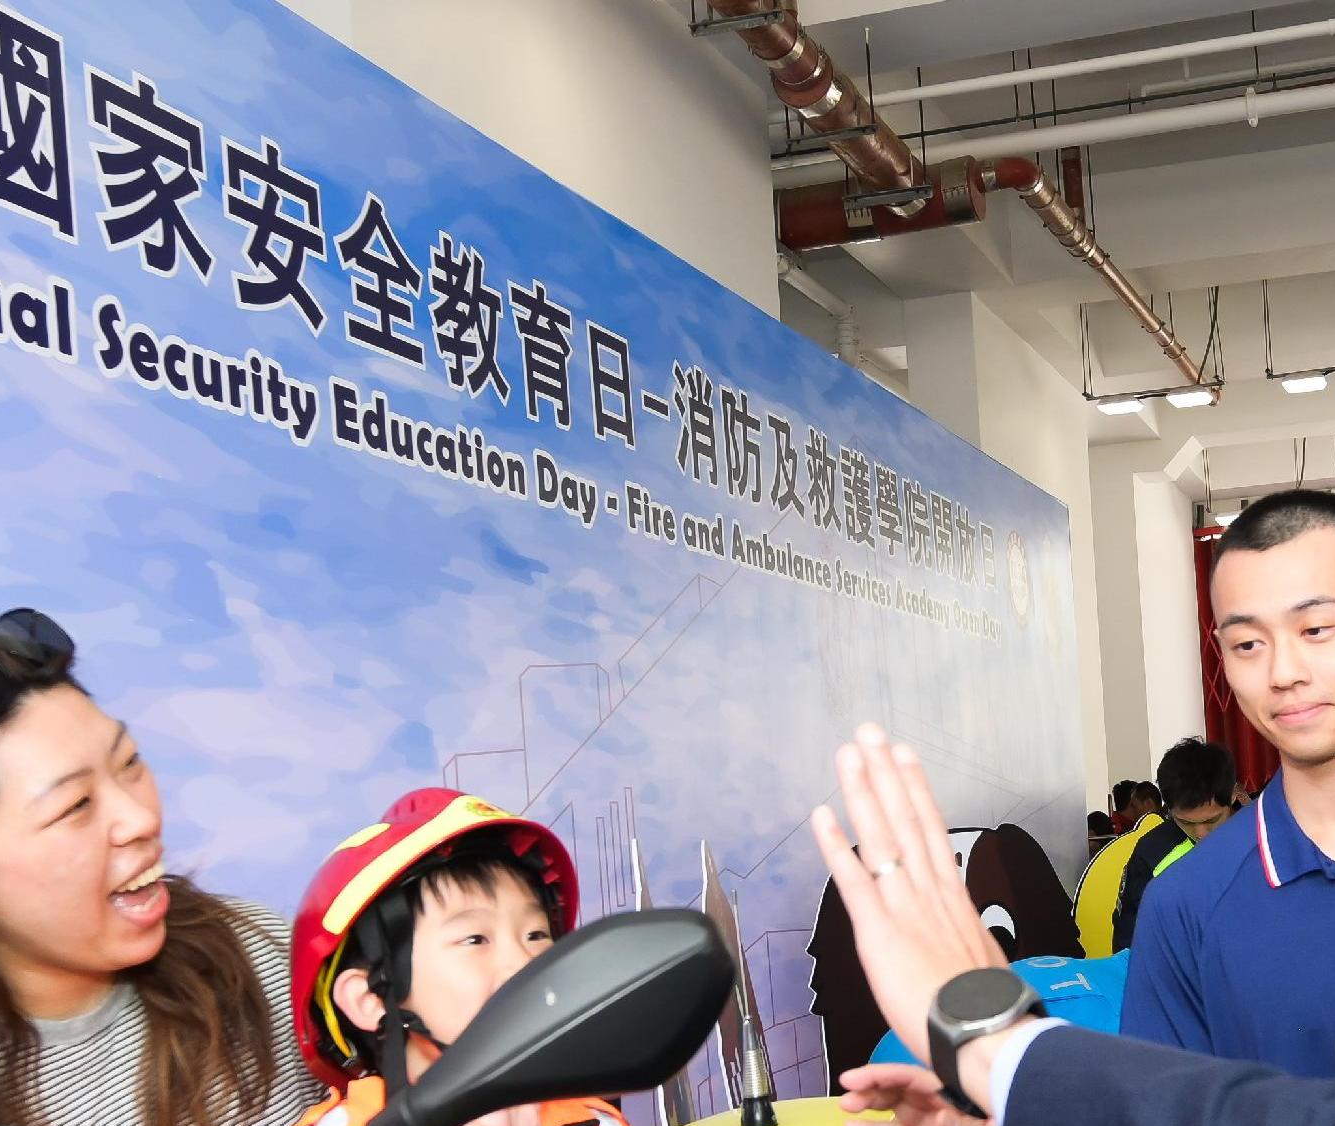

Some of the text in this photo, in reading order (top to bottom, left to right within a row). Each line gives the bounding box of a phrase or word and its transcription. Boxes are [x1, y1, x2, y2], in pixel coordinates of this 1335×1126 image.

[100, 303, 316, 439] Security
[332, 382, 526, 496] Education
[535, 456, 597, 523] Day
[607, 496, 617, 512] -
[627, 484, 675, 541] Fire
[683, 516, 725, 557] and
[732, 523, 831, 587] Ambulance
[836, 559, 892, 607] Services
[895, 580, 950, 628] Academy
[982, 610, 1002, 647] Day
